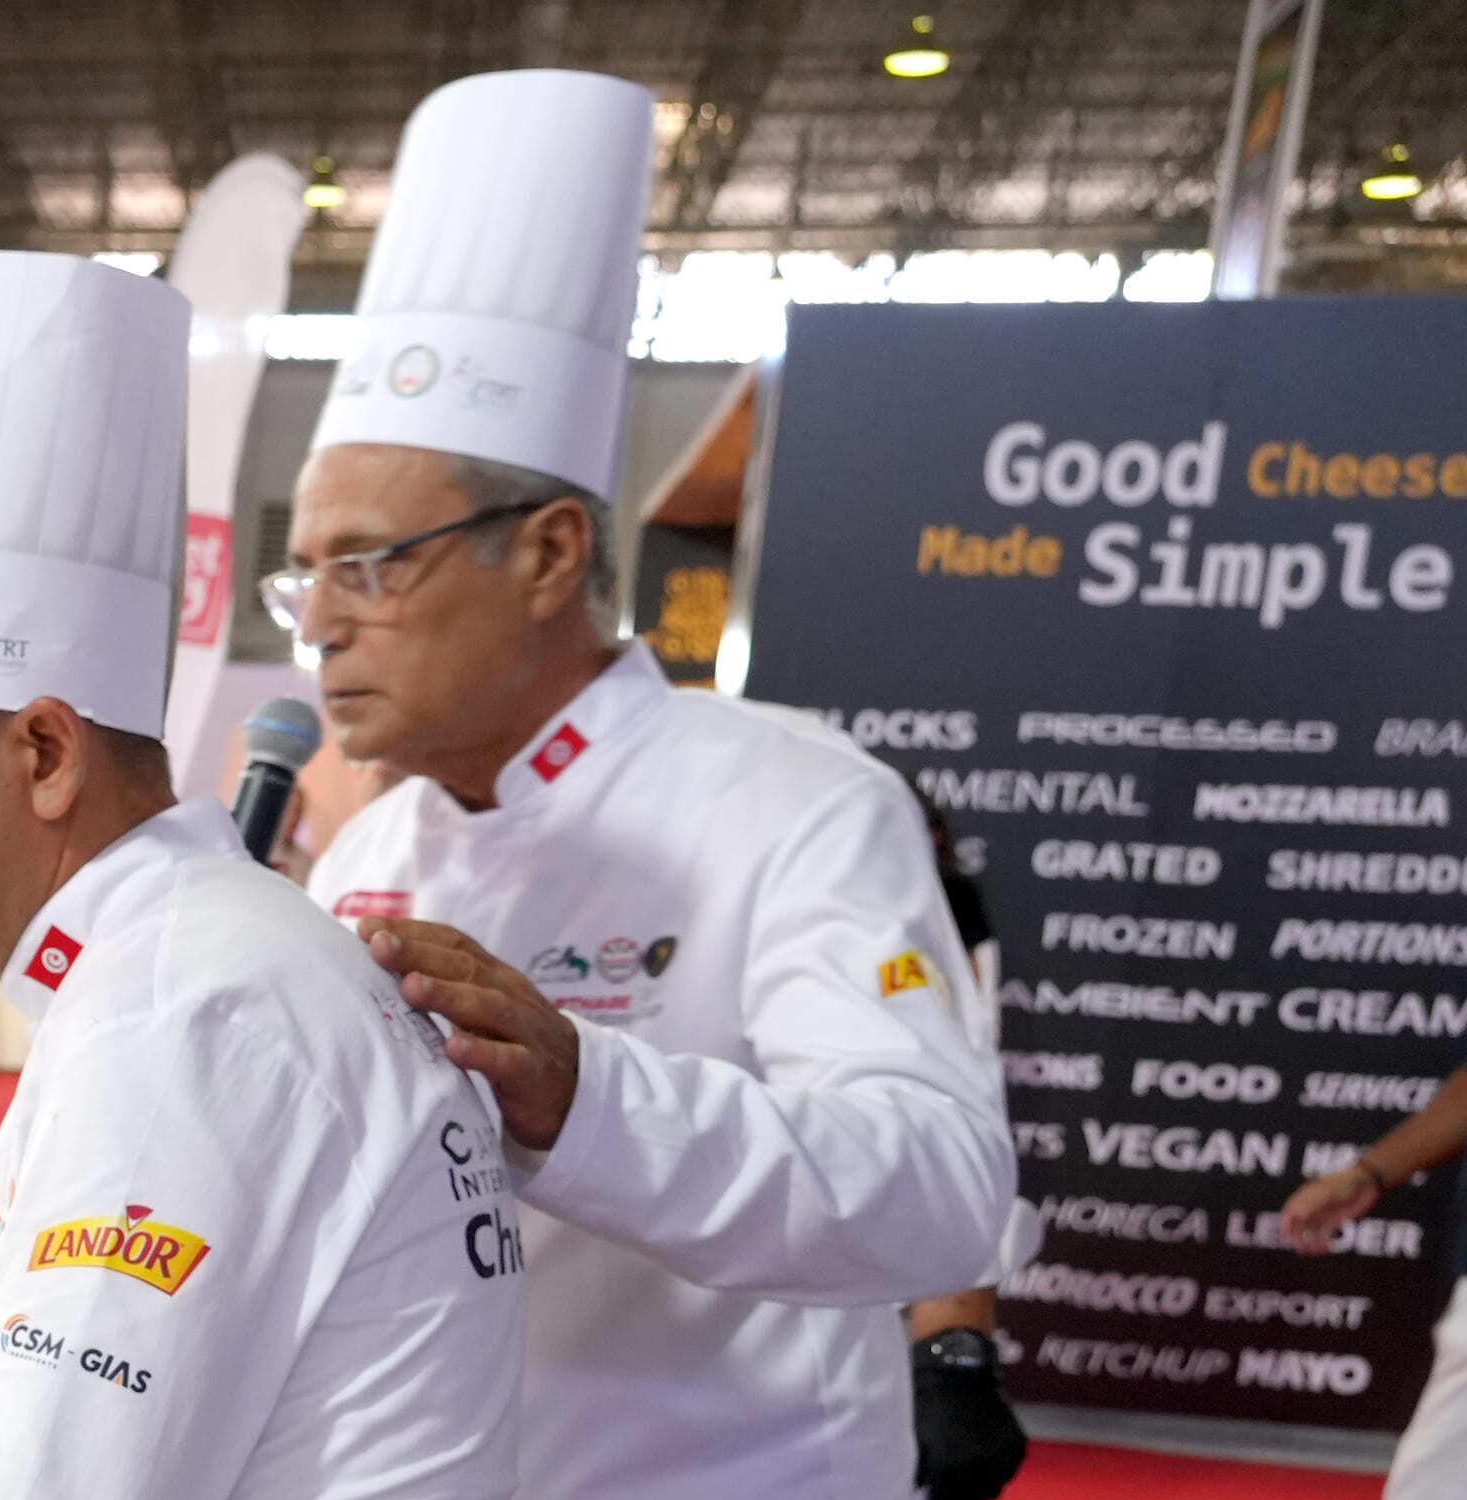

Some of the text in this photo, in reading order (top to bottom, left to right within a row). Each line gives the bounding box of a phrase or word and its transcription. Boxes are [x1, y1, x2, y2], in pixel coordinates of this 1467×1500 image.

[982, 421, 1228, 507] Good
[917, 516, 1453, 628] Made Simple
[1017, 711, 1338, 752] PROCESSED
[1374, 717, 1467, 757] BRA
[1193, 783, 1450, 827] MOZZARELLA
[1031, 839, 1222, 885] GRATED
[1041, 911, 1237, 960] FROZEN
[1132, 1058, 1282, 1104] FOOD
[1081, 1117, 1289, 1177] VEGAN
[37, 1226, 173, 1280] LANDOR
[1204, 1286, 1372, 1330] EXPORT
[11, 1324, 153, 1394] CSM GIAS
[1036, 1335, 1231, 1383] KETCHUP
[1236, 1347, 1373, 1396] MAYO
